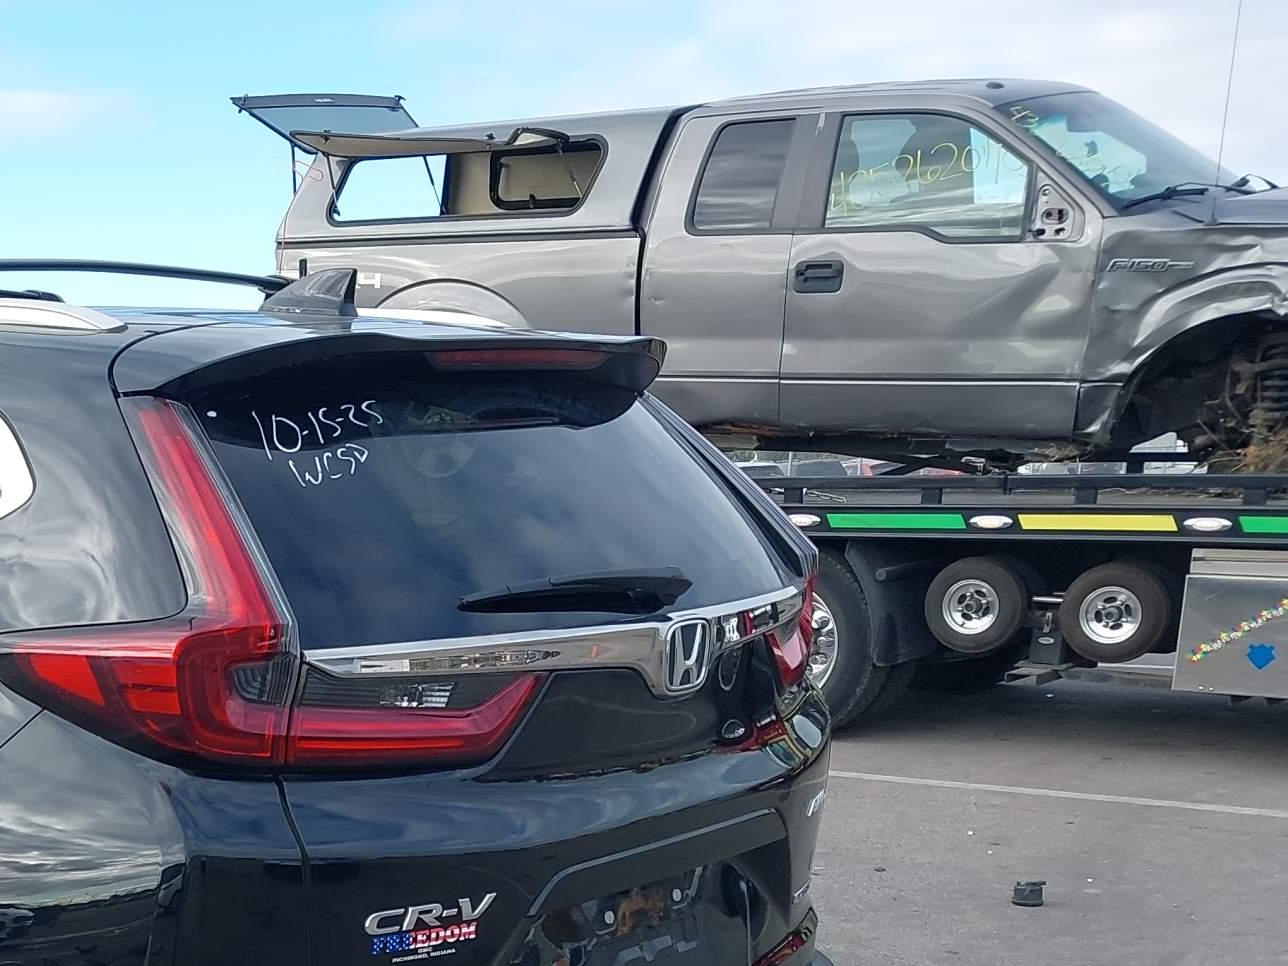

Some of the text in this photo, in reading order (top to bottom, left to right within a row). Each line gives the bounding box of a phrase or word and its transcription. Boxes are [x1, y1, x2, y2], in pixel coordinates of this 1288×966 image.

[251, 400, 384, 461] 10-15-25
[364, 892, 497, 935] CR-V
[371, 921, 478, 955] FREEDOM
[392, 948, 457, 963] RICHMOND, INDIANA
